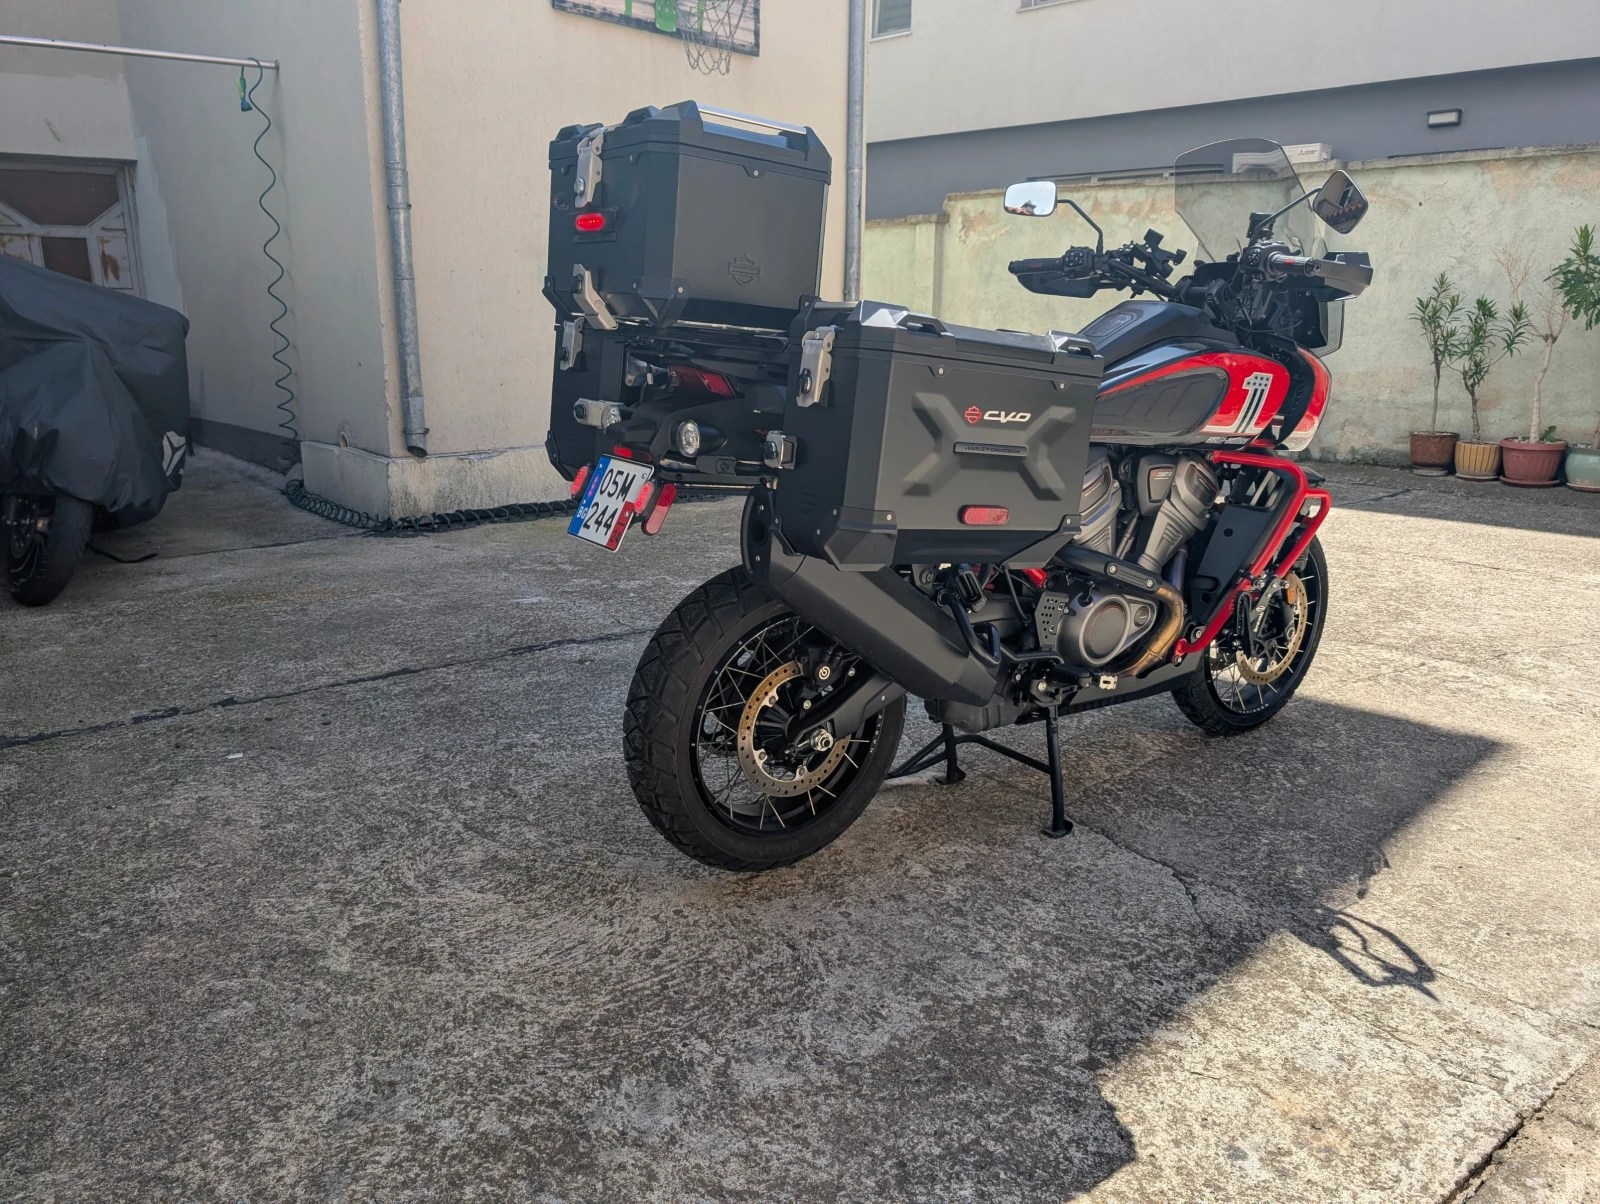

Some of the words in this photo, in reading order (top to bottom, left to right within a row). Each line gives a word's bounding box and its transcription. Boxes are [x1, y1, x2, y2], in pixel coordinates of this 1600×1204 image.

[983, 410, 1031, 423] CVO
[600, 468, 636, 502] 05M
[576, 506, 589, 519] BG
[582, 502, 618, 536] 244
